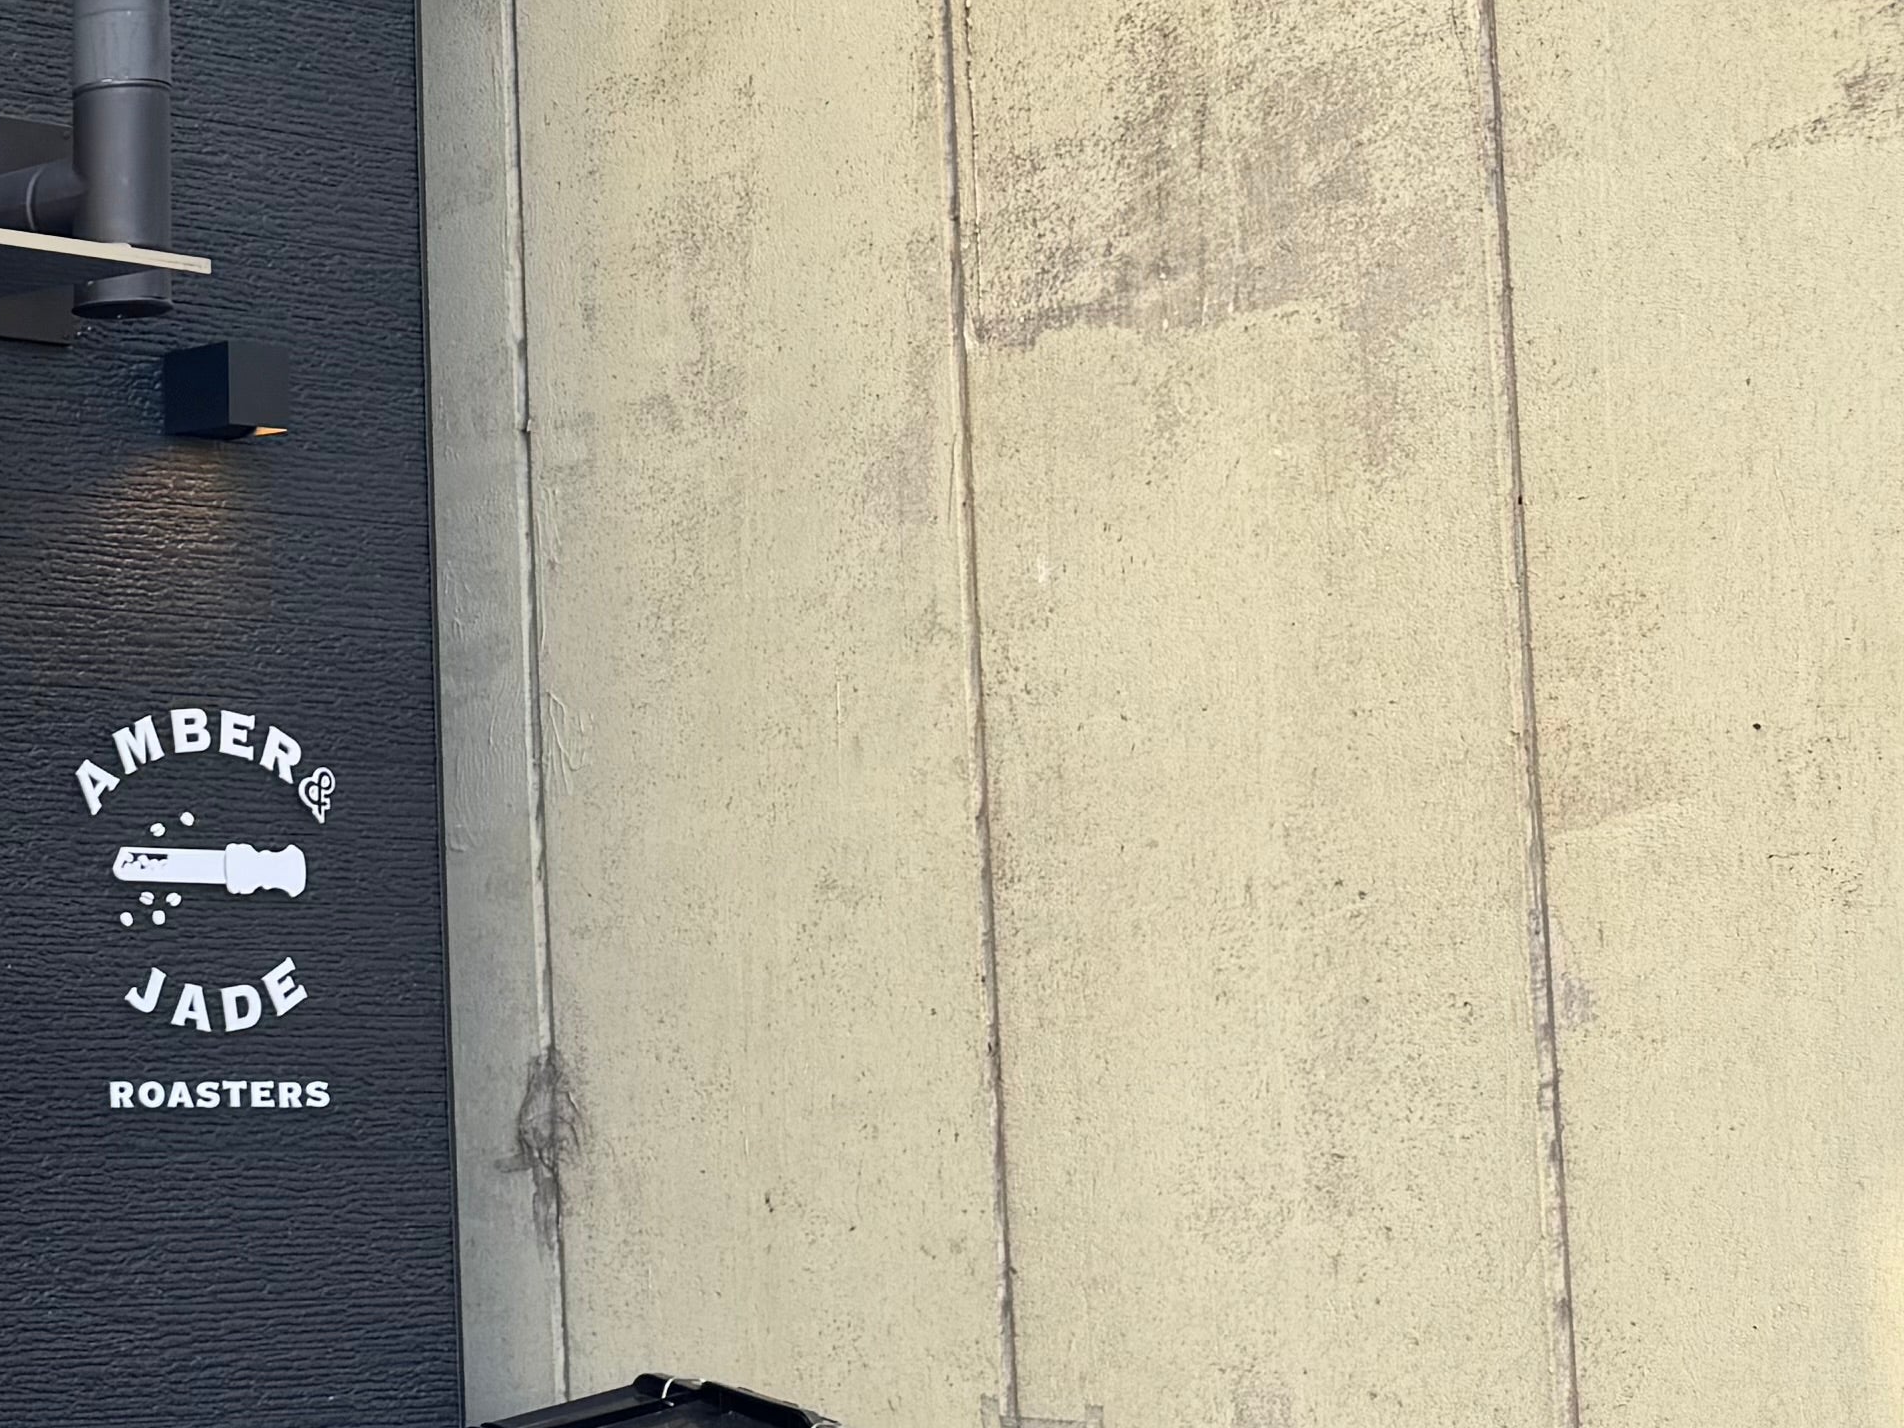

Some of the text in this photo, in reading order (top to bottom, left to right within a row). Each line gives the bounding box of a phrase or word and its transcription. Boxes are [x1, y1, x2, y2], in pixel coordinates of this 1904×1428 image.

[75, 708, 302, 816] AMBER
[124, 957, 308, 1033] JADE
[109, 1081, 330, 1109] ROASTERS
